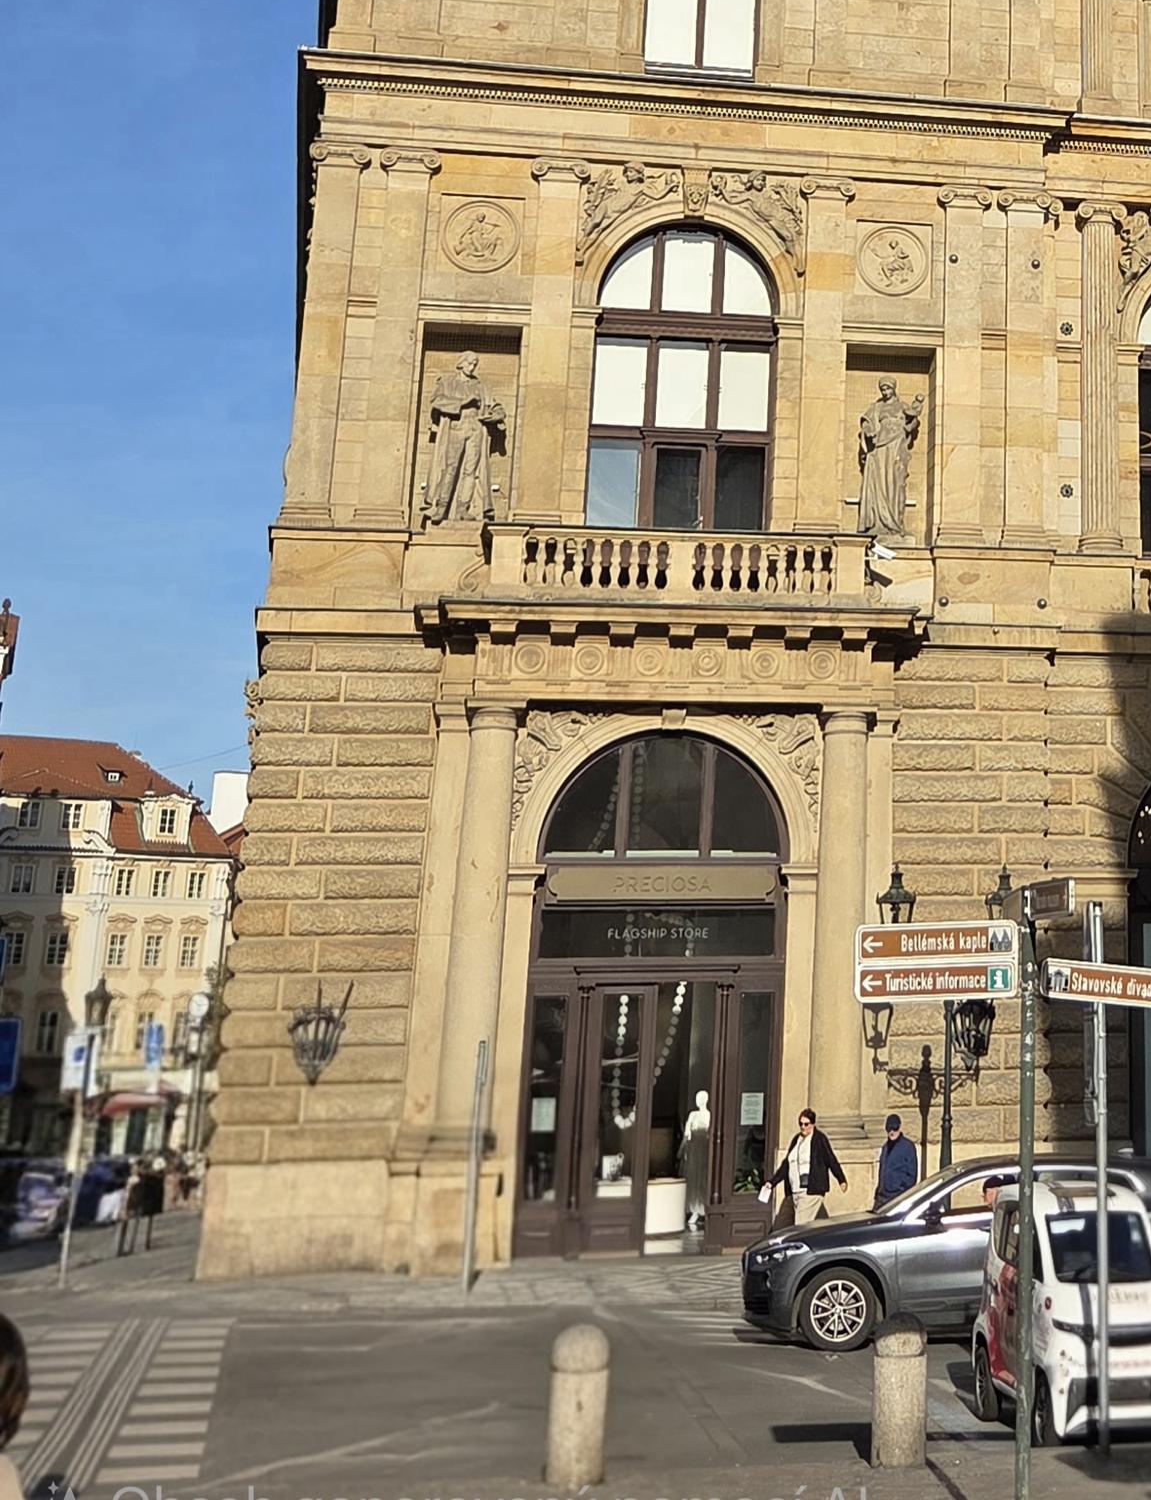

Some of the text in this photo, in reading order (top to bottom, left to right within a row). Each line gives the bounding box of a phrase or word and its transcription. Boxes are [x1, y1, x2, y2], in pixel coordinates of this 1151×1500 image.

[612, 876, 713, 893] PRECIOSA
[607, 927, 709, 940] FLAGSHIP STORE
[901, 931, 987, 952] Betlémská kaple
[885, 971, 986, 992] Turistické informace
[1072, 972, 1123, 995] Stavovské
